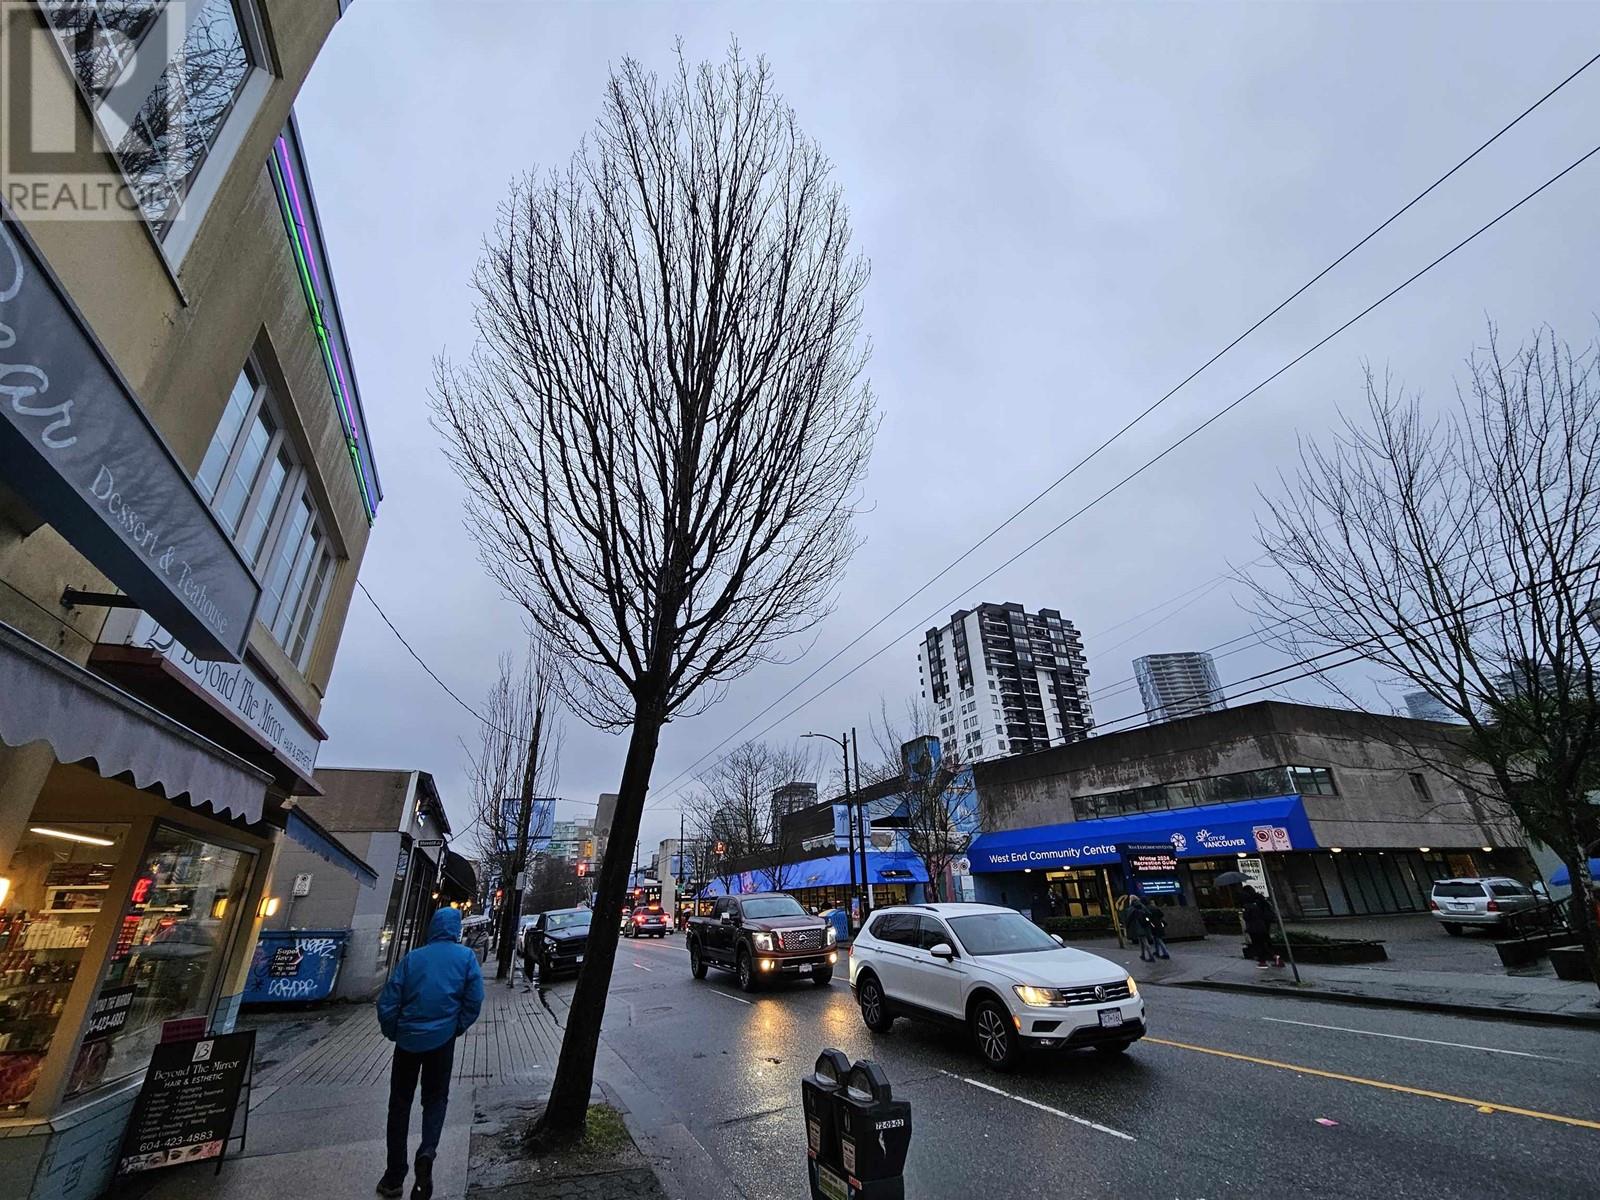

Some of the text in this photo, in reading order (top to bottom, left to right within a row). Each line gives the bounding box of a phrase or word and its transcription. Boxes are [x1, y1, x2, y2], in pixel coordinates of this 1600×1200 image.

[88, 463, 161, 559] Dessert
[158, 544, 176, 577] &
[175, 559, 229, 635] Teahouse
[181, 650, 285, 744] eyond The Mirror
[989, 854, 1010, 863] West
[1011, 852, 1028, 862] End
[1029, 848, 1080, 861] Community
[1083, 844, 1117, 856] Centre
[1203, 839, 1246, 848] VANCOUVER
[154, 1060, 240, 1081] Beyond The Mirror
[164, 1079, 182, 1088] HAIR
[192, 1072, 224, 1084] ESTHETIC
[139, 1130, 214, 1152] 604-423-4883
